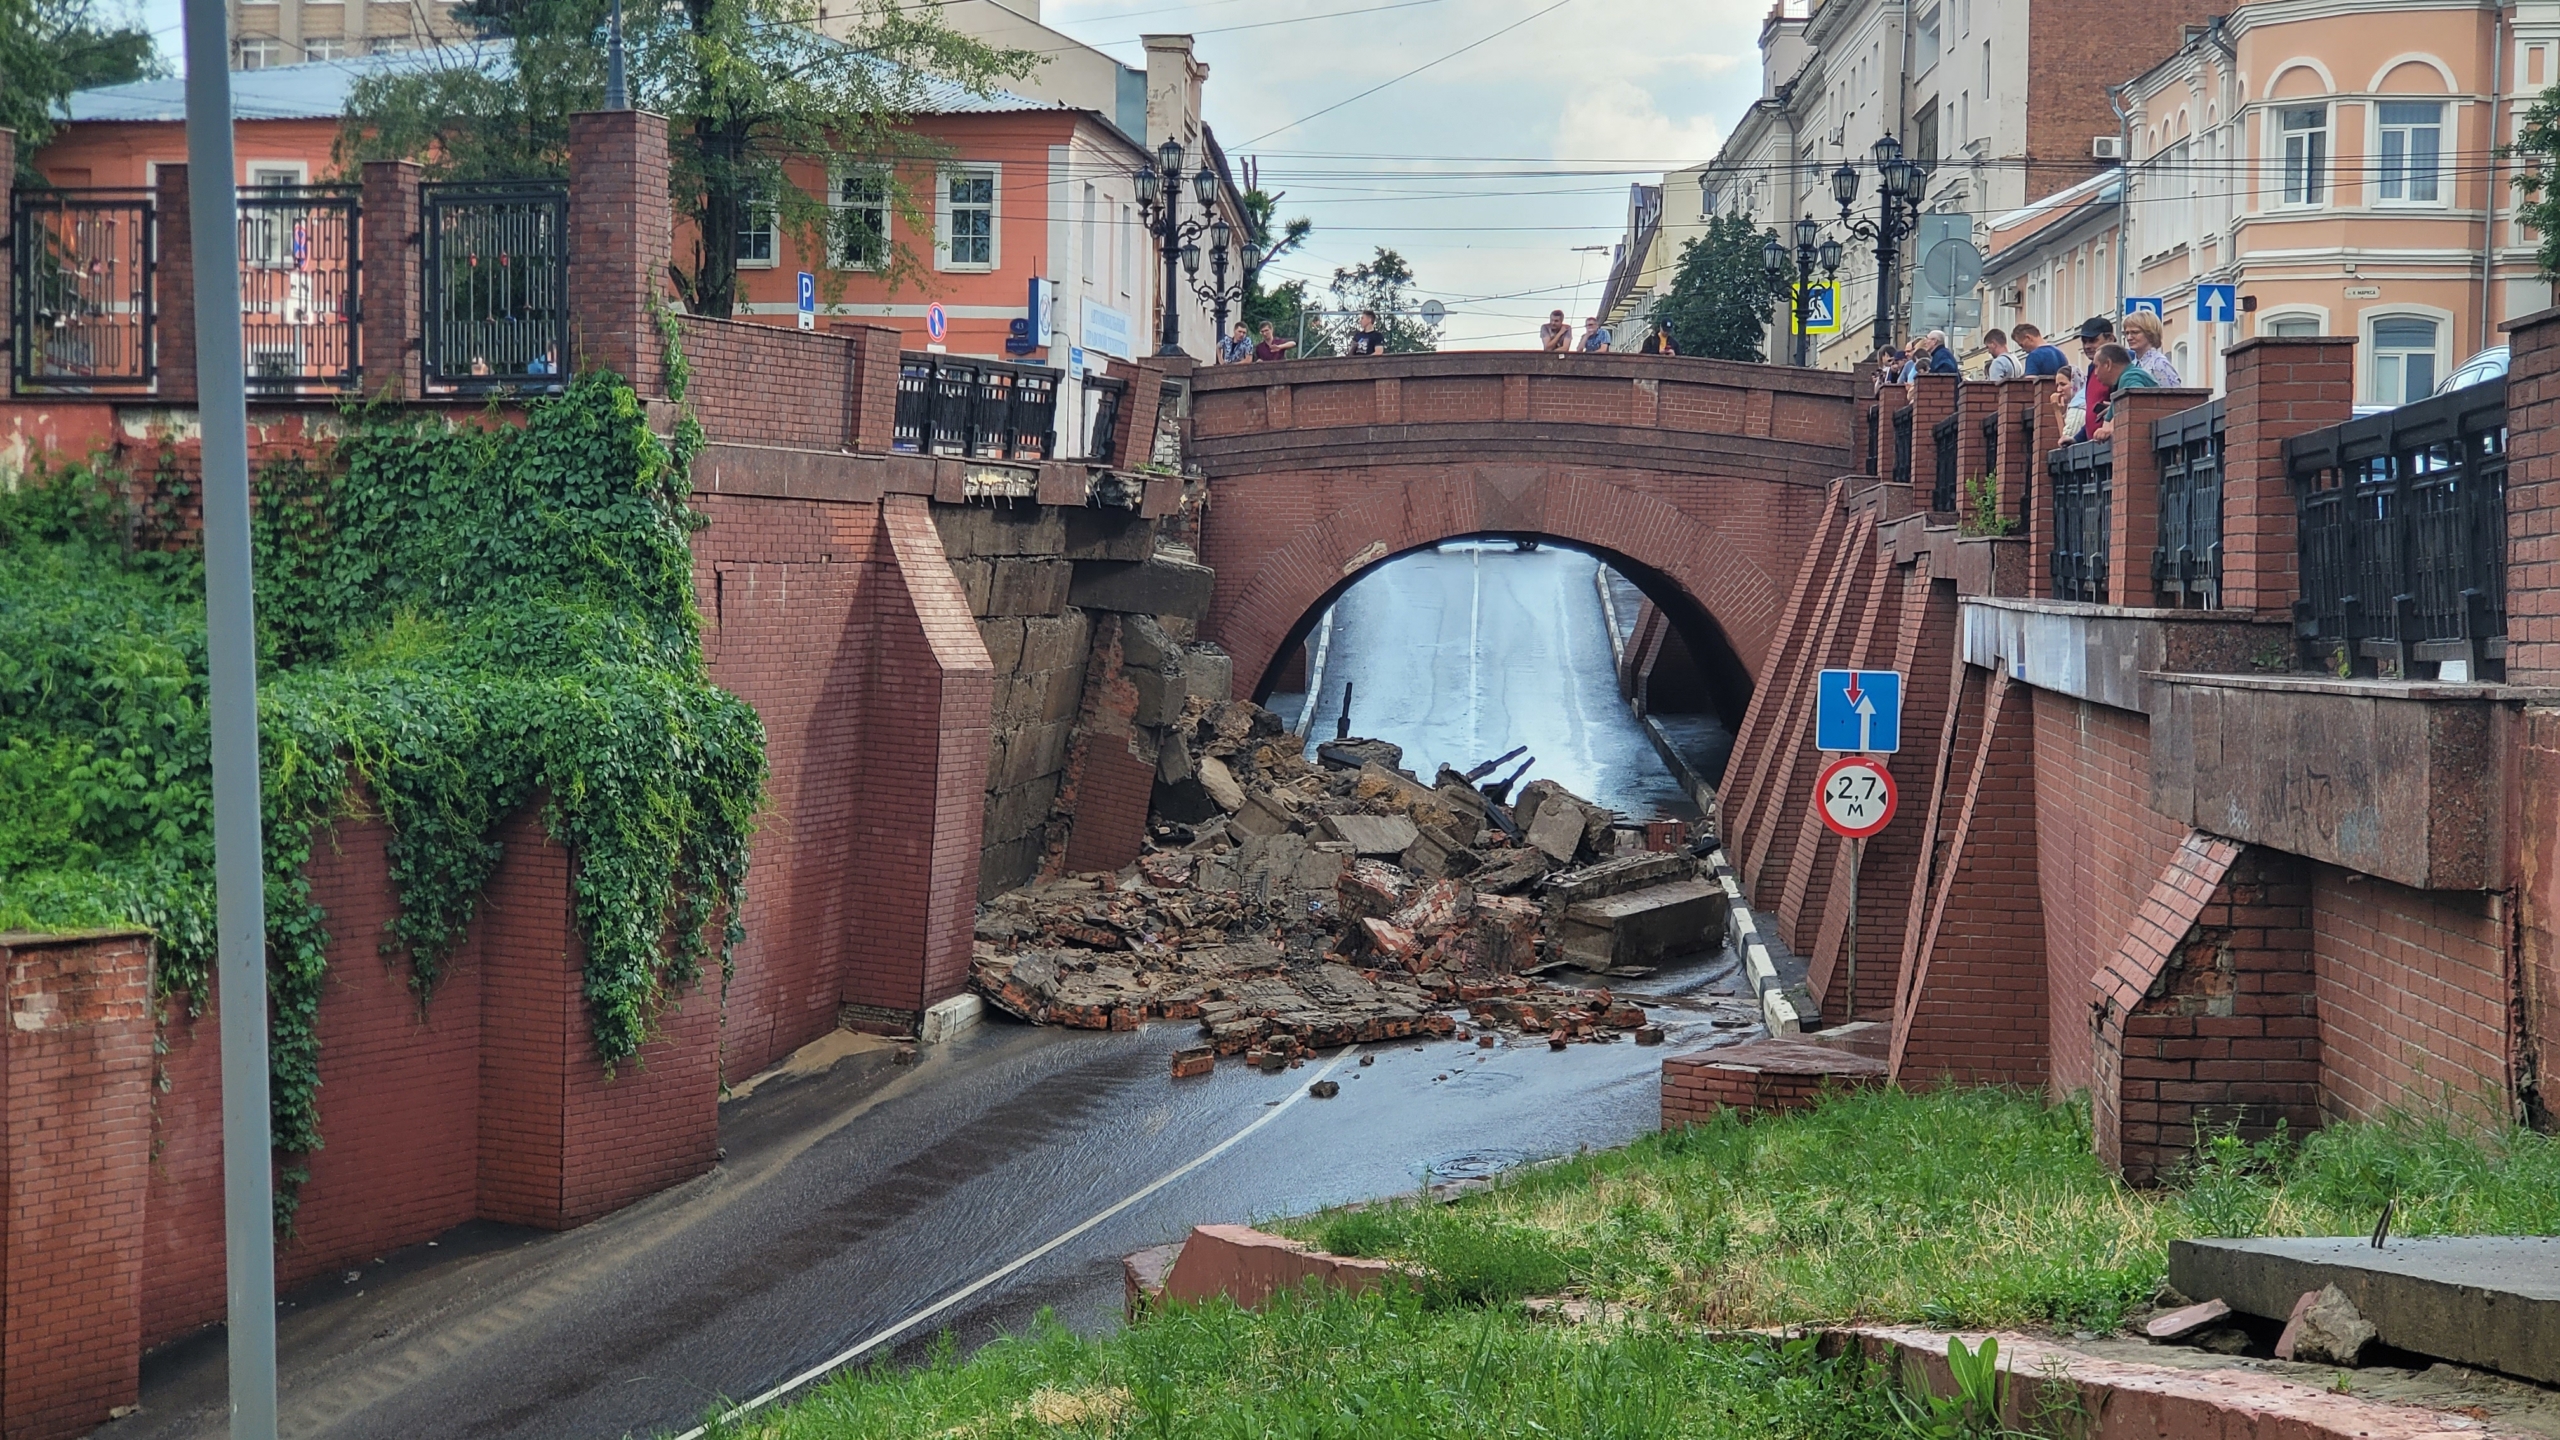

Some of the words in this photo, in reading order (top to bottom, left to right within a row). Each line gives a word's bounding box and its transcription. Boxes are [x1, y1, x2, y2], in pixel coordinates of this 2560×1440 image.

[802, 277, 812, 308] P
[1015, 322, 1024, 330] 43
[1838, 776, 1876, 802] 2,7
